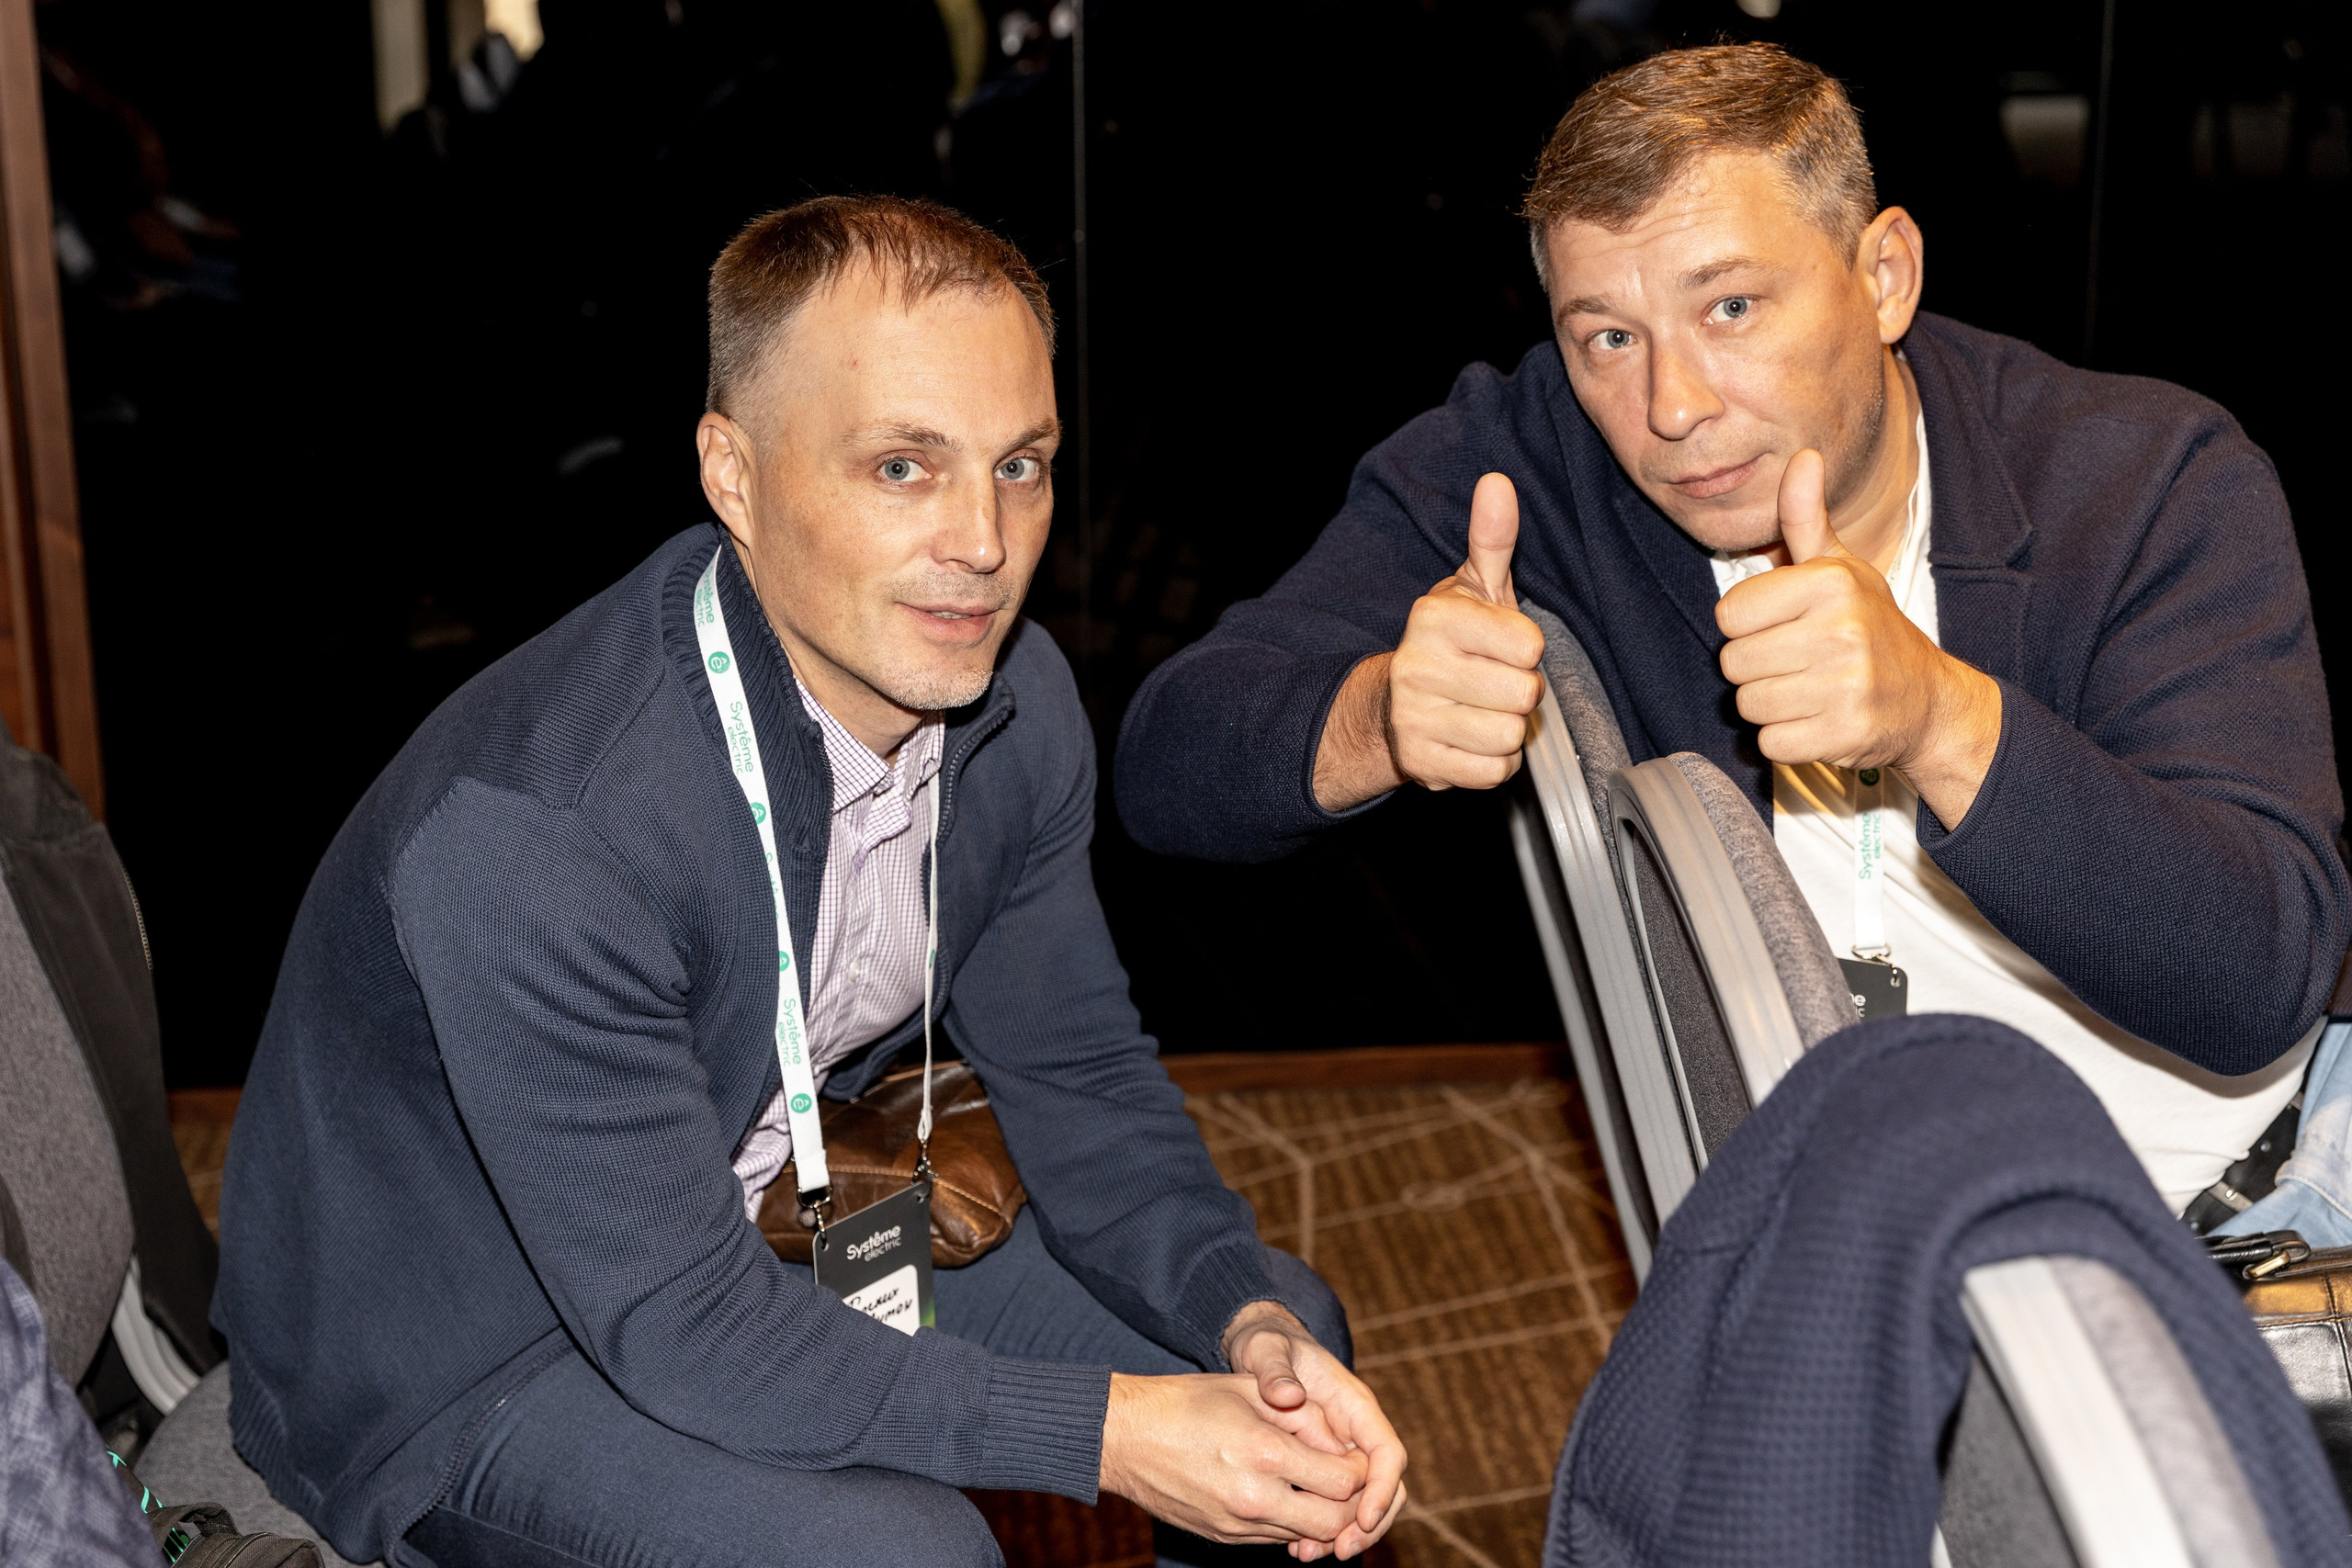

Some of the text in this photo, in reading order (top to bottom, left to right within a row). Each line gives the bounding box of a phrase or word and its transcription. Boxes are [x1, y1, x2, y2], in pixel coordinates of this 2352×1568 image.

[727, 726, 744, 775] electric
[730, 701, 754, 773] Systême
[776, 1021, 791, 1067] electric
[783, 998, 802, 1066] Systême
[846, 1224, 902, 1260] Systême
[864, 1236, 902, 1262] electric
